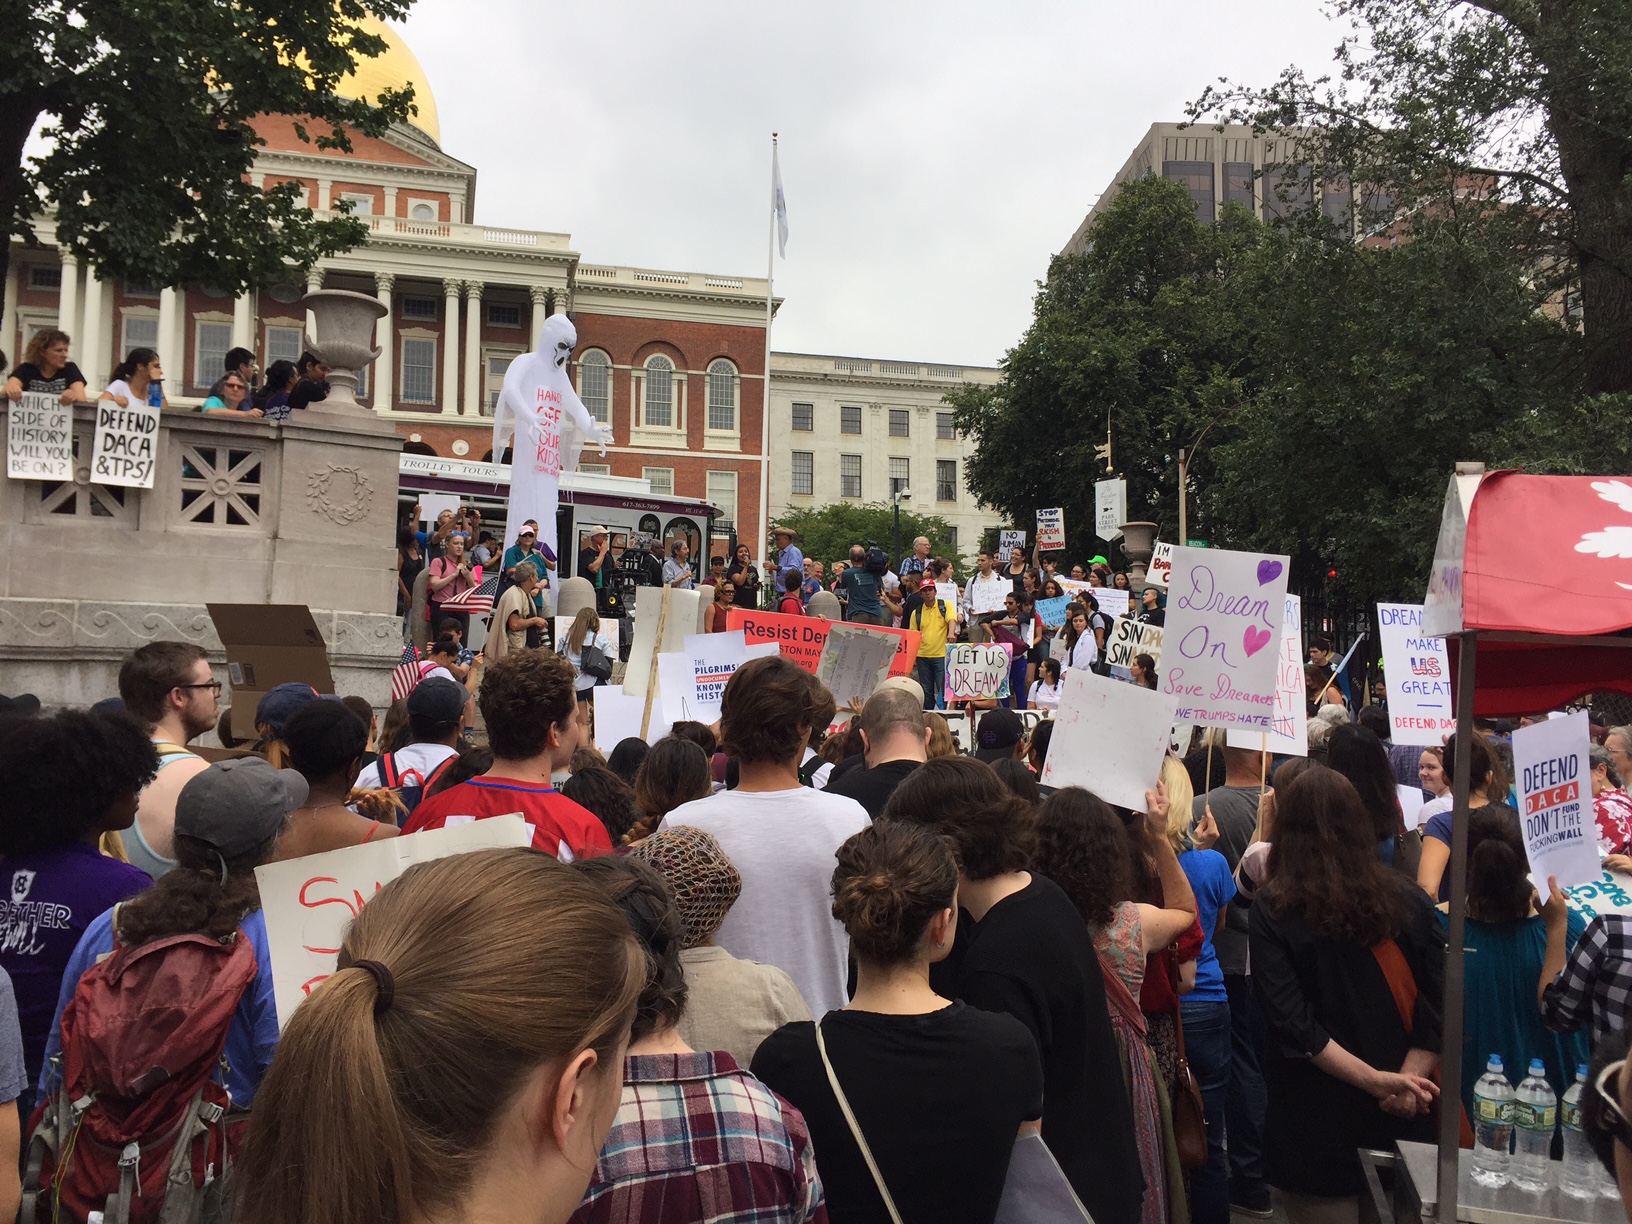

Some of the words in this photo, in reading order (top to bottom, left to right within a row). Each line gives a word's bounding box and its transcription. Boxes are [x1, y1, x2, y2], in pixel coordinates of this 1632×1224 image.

[15, 396, 60, 411] WHICH
[12, 411, 45, 426] SIDE
[50, 414, 68, 428] OF
[100, 408, 156, 434] DEFEND
[11, 428, 67, 444] HISTORY
[10, 444, 42, 459] WILL
[45, 446, 71, 460] YOU
[103, 433, 152, 458] DACA
[12, 460, 28, 473] BE
[403, 460, 454, 472] TROLLEY
[462, 466, 498, 477] TOURS
[1038, 509, 1059, 517] STOP
[1005, 531, 1018, 539] NO
[1000, 540, 1024, 548] HUMAN
[1157, 545, 1170, 557] I'M
[1178, 565, 1275, 629] Dream
[743, 620, 797, 640] Resist
[1179, 625, 1238, 668] On
[1406, 638, 1442, 652] MAKE
[694, 658, 705, 666] THE
[957, 650, 979, 664] LET
[985, 651, 1005, 668] US
[695, 663, 736, 675] PILGRIMS
[696, 683, 722, 692] KNOW
[954, 669, 998, 694] DREAM
[1164, 667, 1204, 698] Save
[1210, 673, 1274, 706] Dreamers
[1401, 681, 1452, 695] GREAT
[1193, 709, 1237, 722] TRUMPS
[1237, 714, 1271, 726] HATE
[1395, 716, 1437, 729] DEFEND
[1524, 753, 1578, 794] DEFEND
[1526, 784, 1577, 815] DACA
[1527, 807, 1561, 842] DON'T
[1562, 802, 1580, 816] FUND
[1563, 811, 1581, 829] THE
